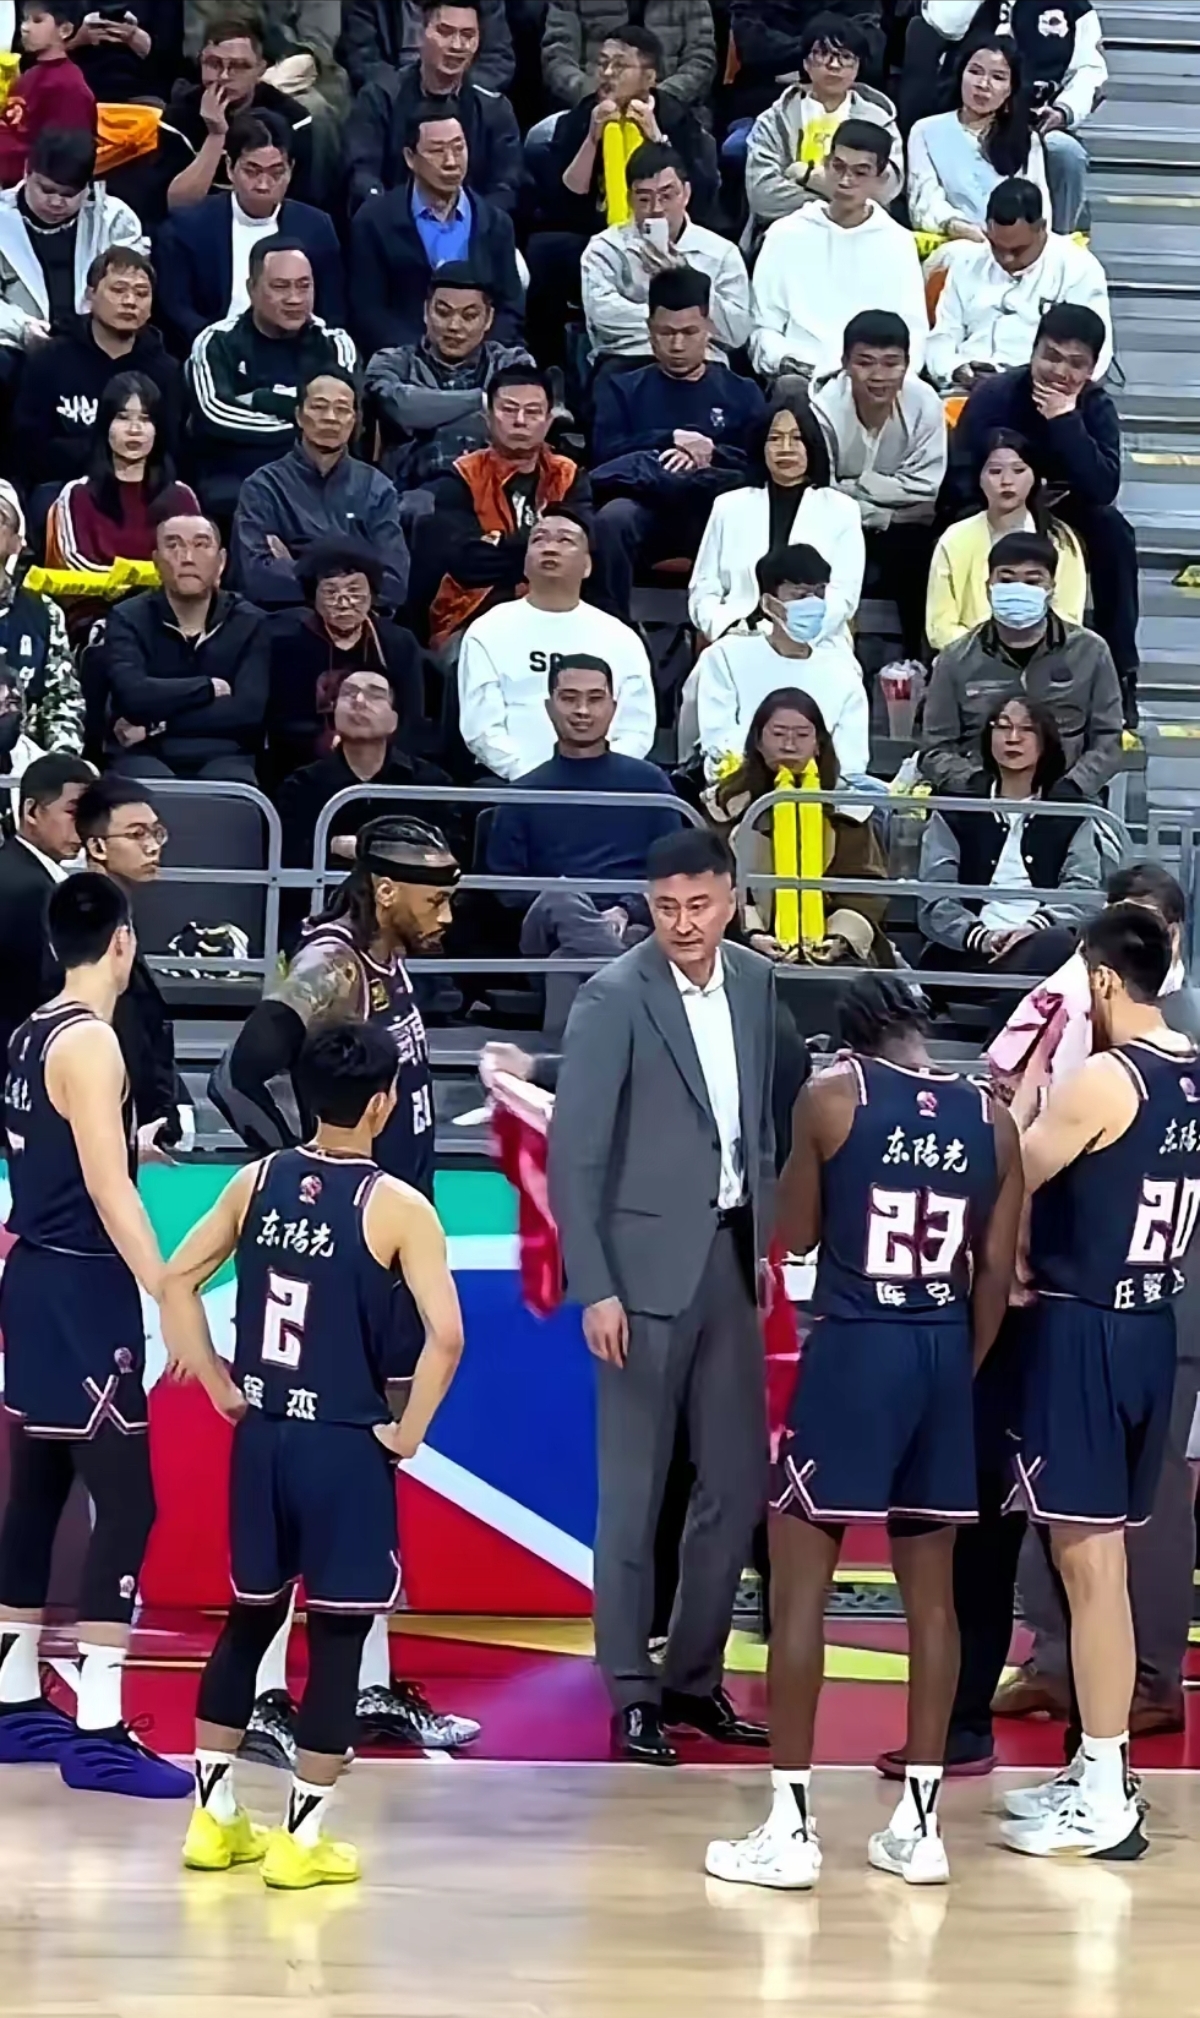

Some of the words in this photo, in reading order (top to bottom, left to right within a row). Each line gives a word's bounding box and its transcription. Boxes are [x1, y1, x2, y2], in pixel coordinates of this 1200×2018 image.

[864, 1182, 969, 1278] 23
[1125, 1174, 1200, 1264] 20
[261, 1266, 311, 1370] 2
